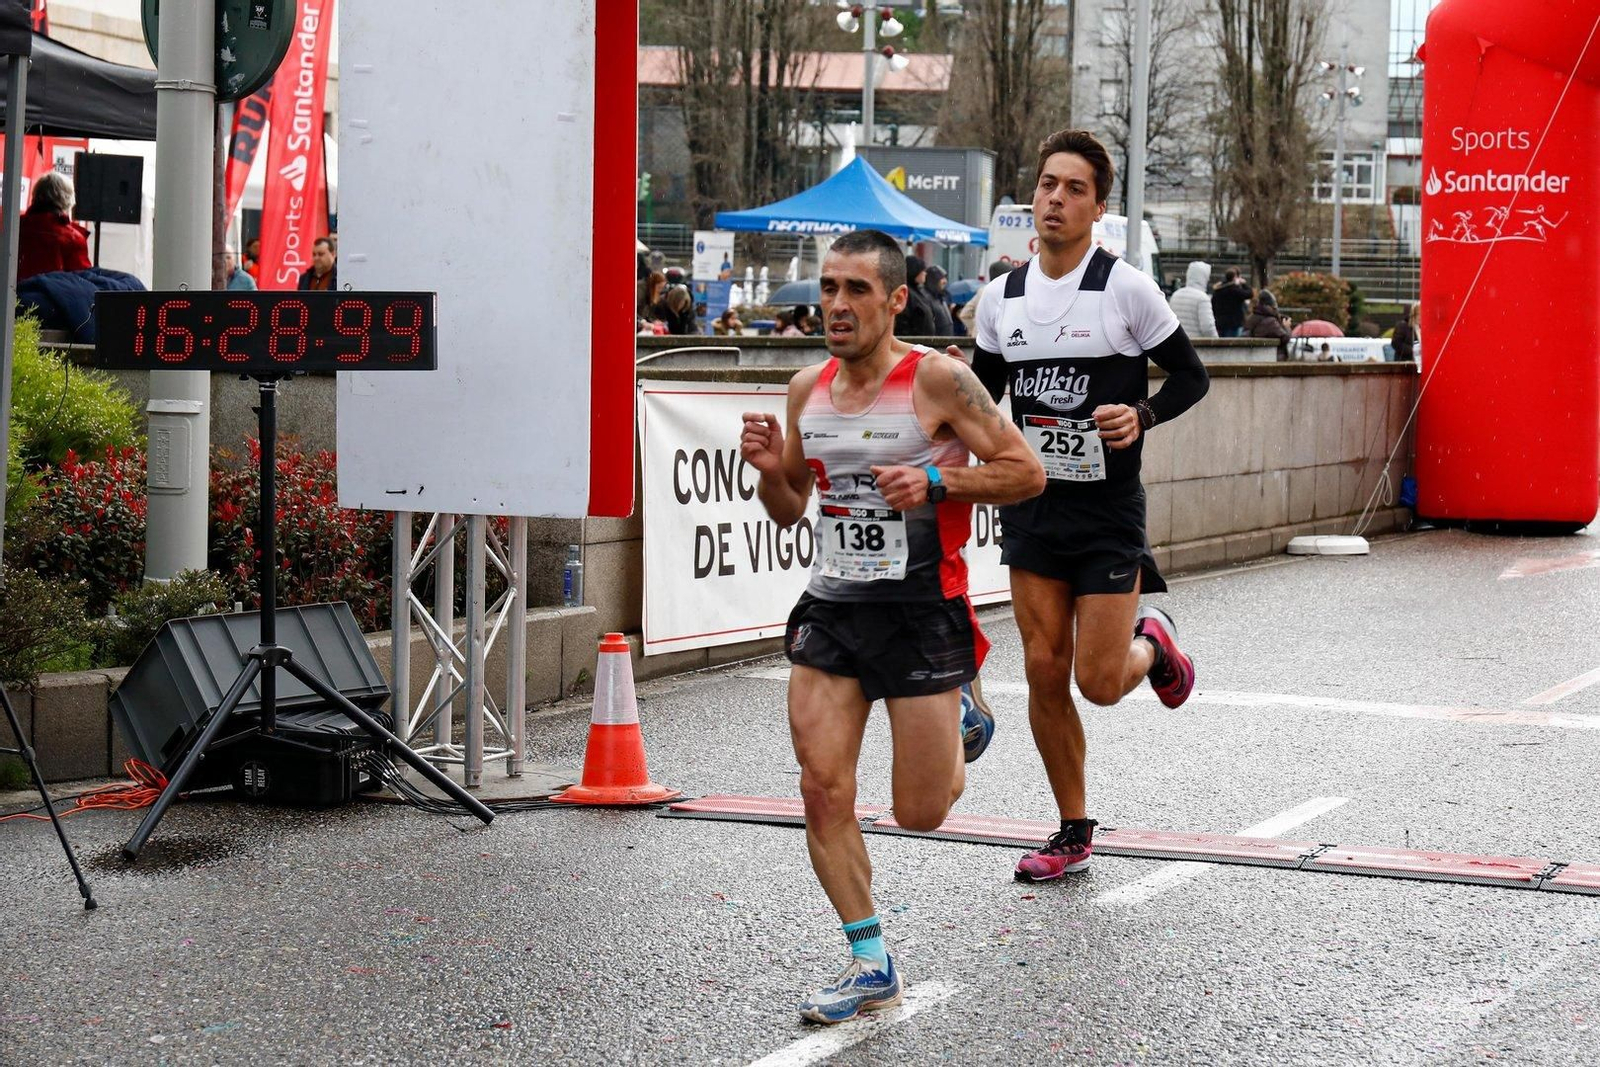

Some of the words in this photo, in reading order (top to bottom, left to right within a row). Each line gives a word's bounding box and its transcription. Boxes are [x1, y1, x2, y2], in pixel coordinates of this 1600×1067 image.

[287, 2, 320, 151] Santander
[1451, 127, 1530, 156] Sports
[908, 174, 960, 190] McFIT
[1444, 170, 1570, 193] Santander
[999, 215, 1020, 228] 902
[1026, 216, 1033, 229] 5
[276, 196, 306, 284] Sports
[134, 300, 422, 362] 16:28.99
[1014, 366, 1090, 397] delikia
[1050, 394, 1074, 405] fresh
[1040, 430, 1086, 457] 252
[673, 448, 755, 505] CONC
[694, 522, 735, 579] DE
[743, 517, 814, 573] VIGO
[835, 522, 885, 551] 138
[244, 769, 253, 786] TEAM
[257, 768, 265, 787] RELAY
